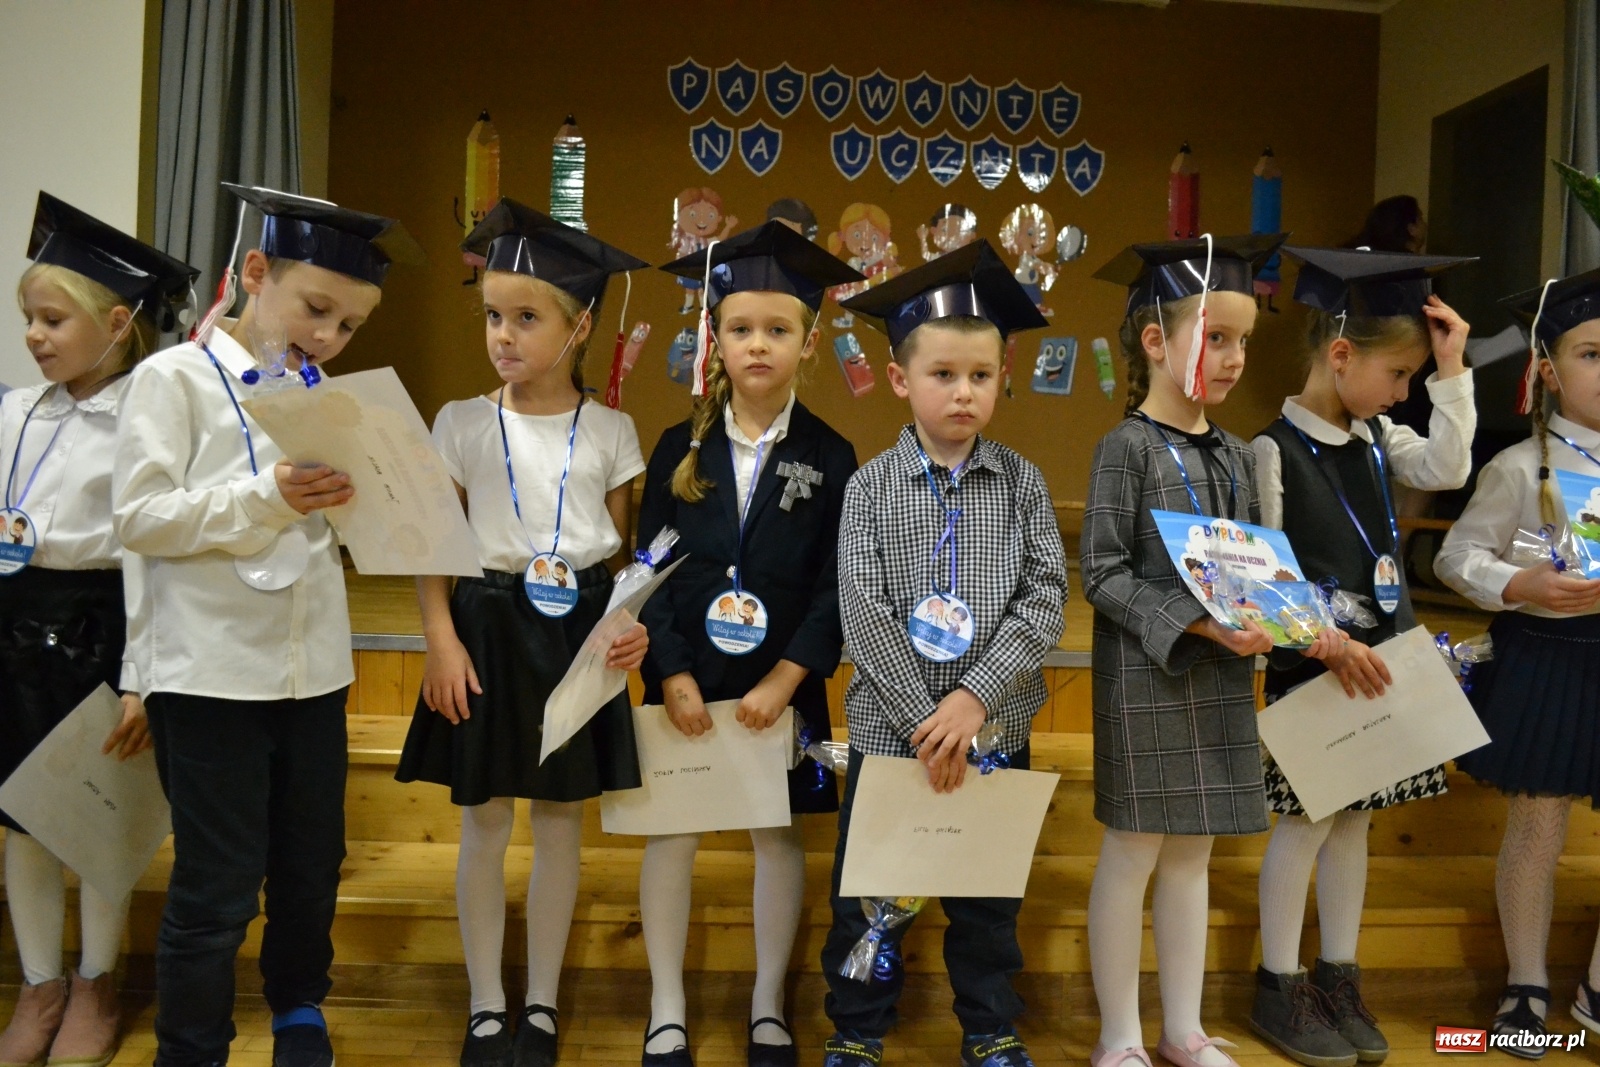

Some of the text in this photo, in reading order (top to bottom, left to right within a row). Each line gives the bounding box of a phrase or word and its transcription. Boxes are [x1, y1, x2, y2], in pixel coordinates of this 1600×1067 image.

[680, 72, 1070, 125] PASOWANIE
[700, 131, 1092, 182] NA UCZNIA
[1203, 525, 1255, 546] DYPLOM
[1204, 549, 1238, 563] PWANIA
